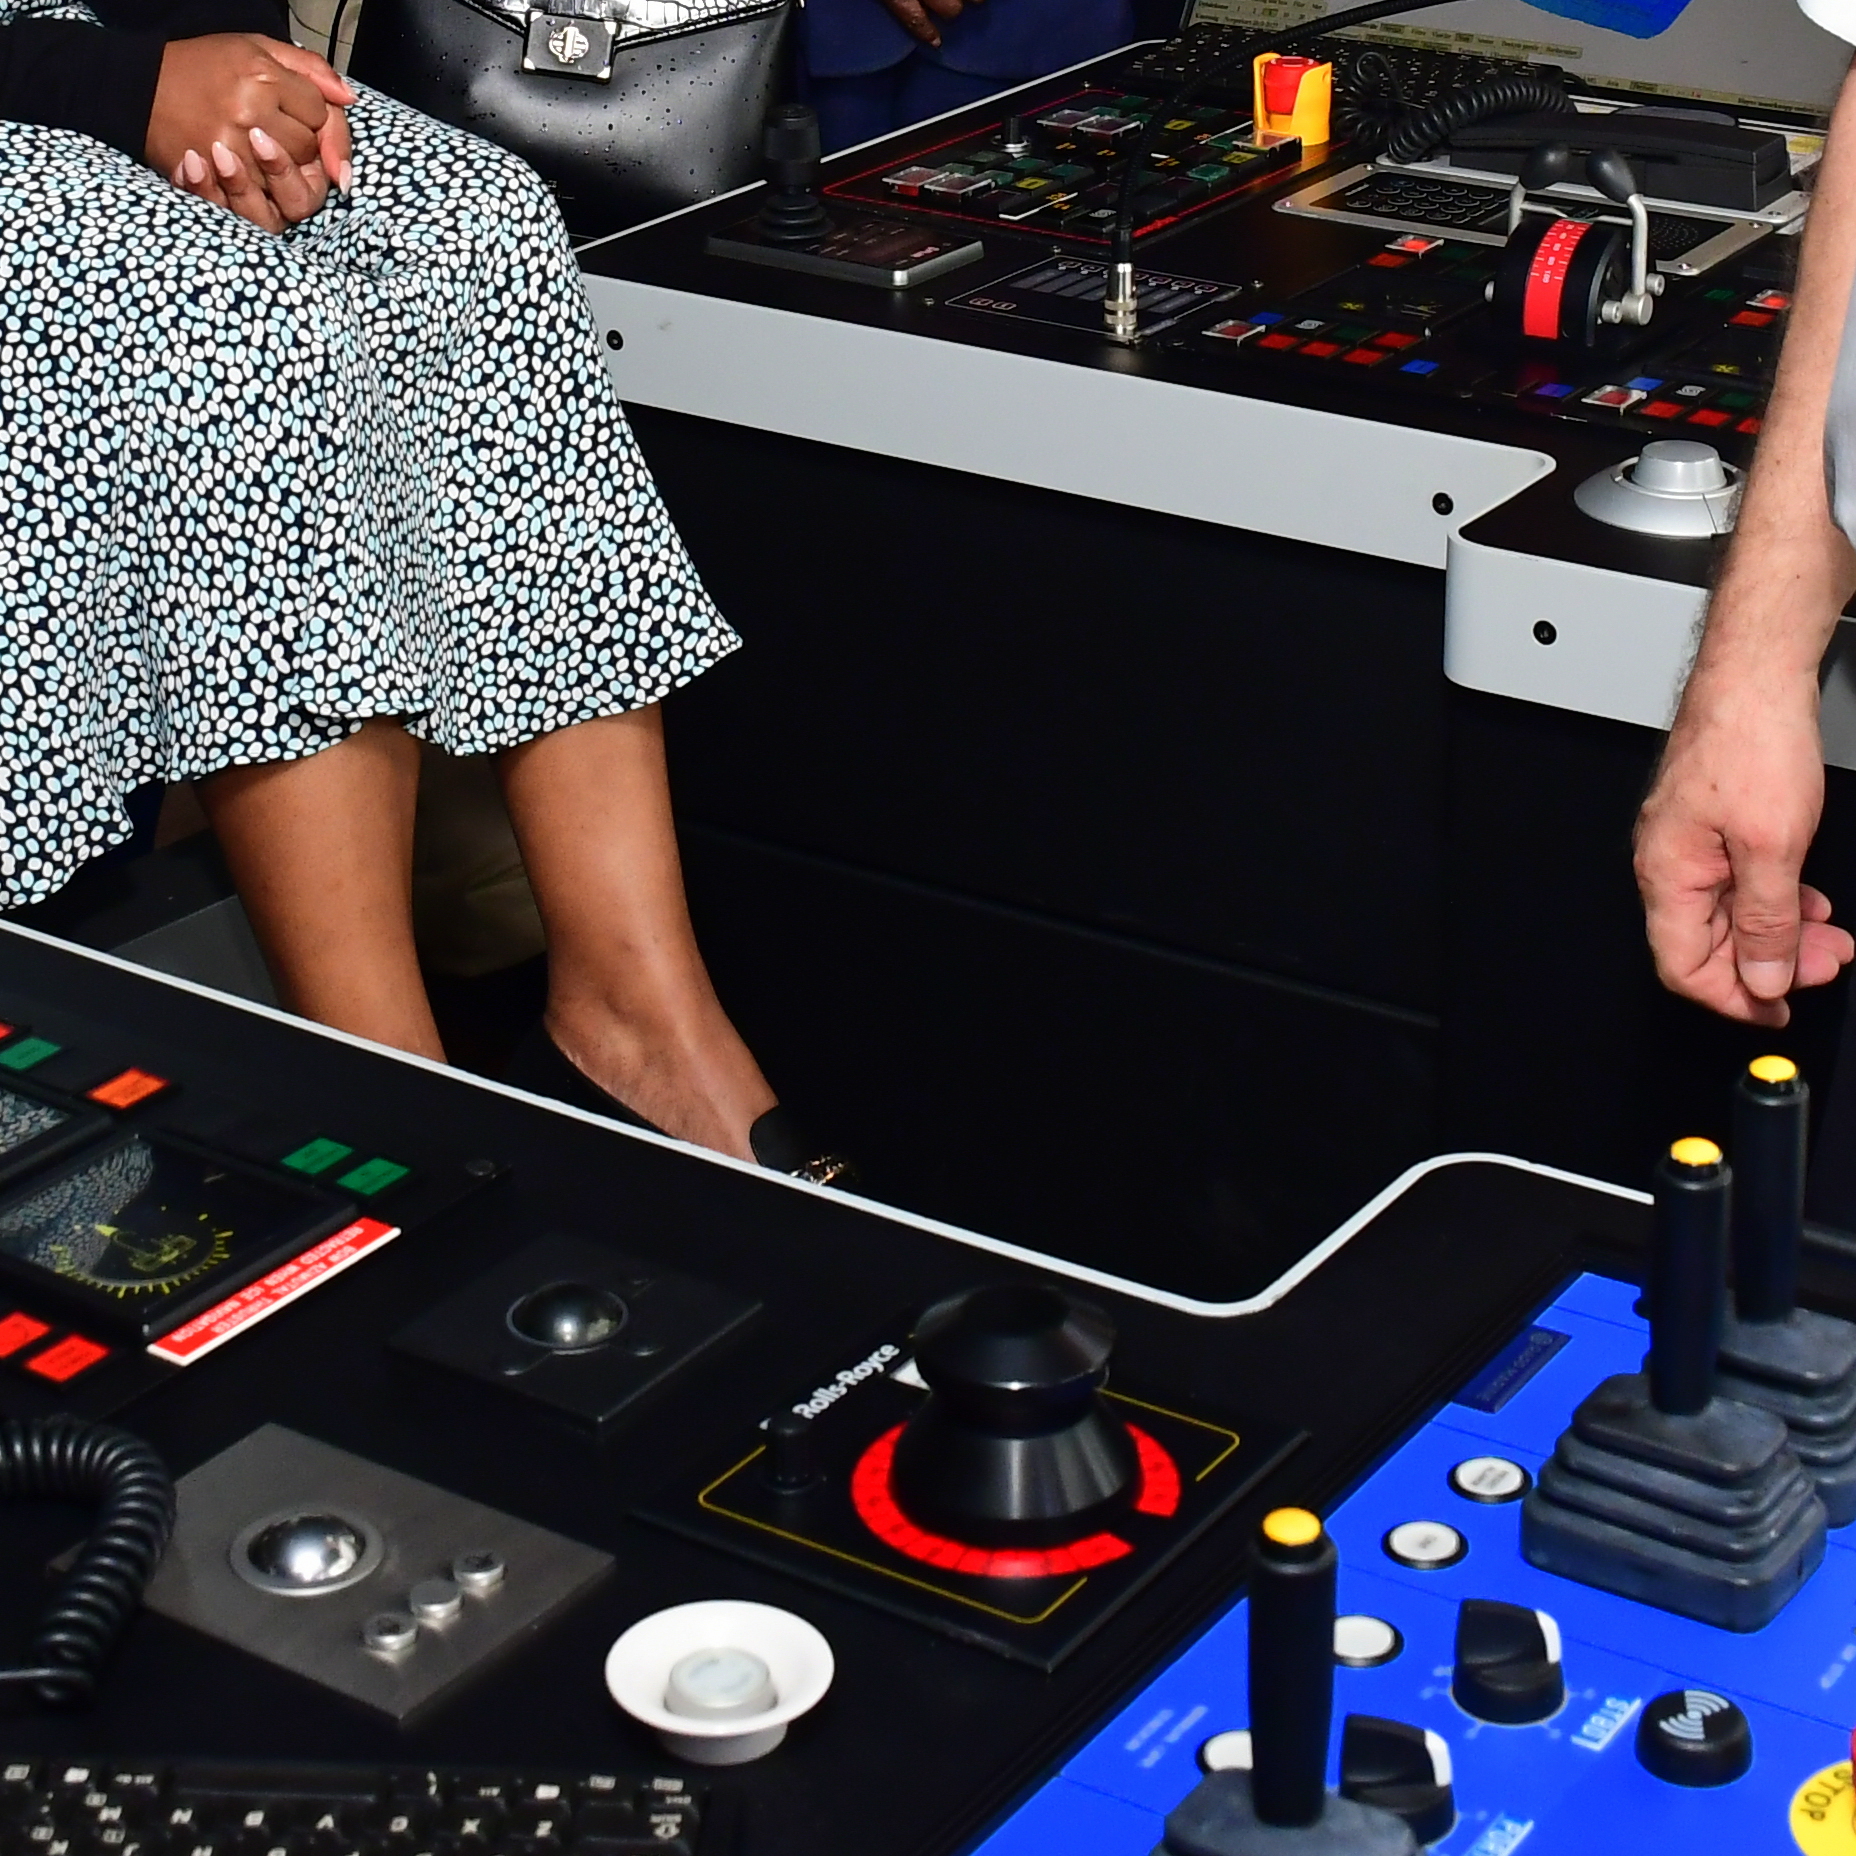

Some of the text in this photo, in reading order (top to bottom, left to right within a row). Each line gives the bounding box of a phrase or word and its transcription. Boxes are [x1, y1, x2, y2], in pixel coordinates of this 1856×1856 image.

[327, 1245, 359, 1263] BOW
[171, 1227, 365, 1342] RETRACTED WHEN ICE NAVIGATION
[211, 1297, 274, 1333] THRUSTER
[792, 1344, 900, 1420] Rolls-Royce
[1800, 1768, 1854, 1822] STOP
